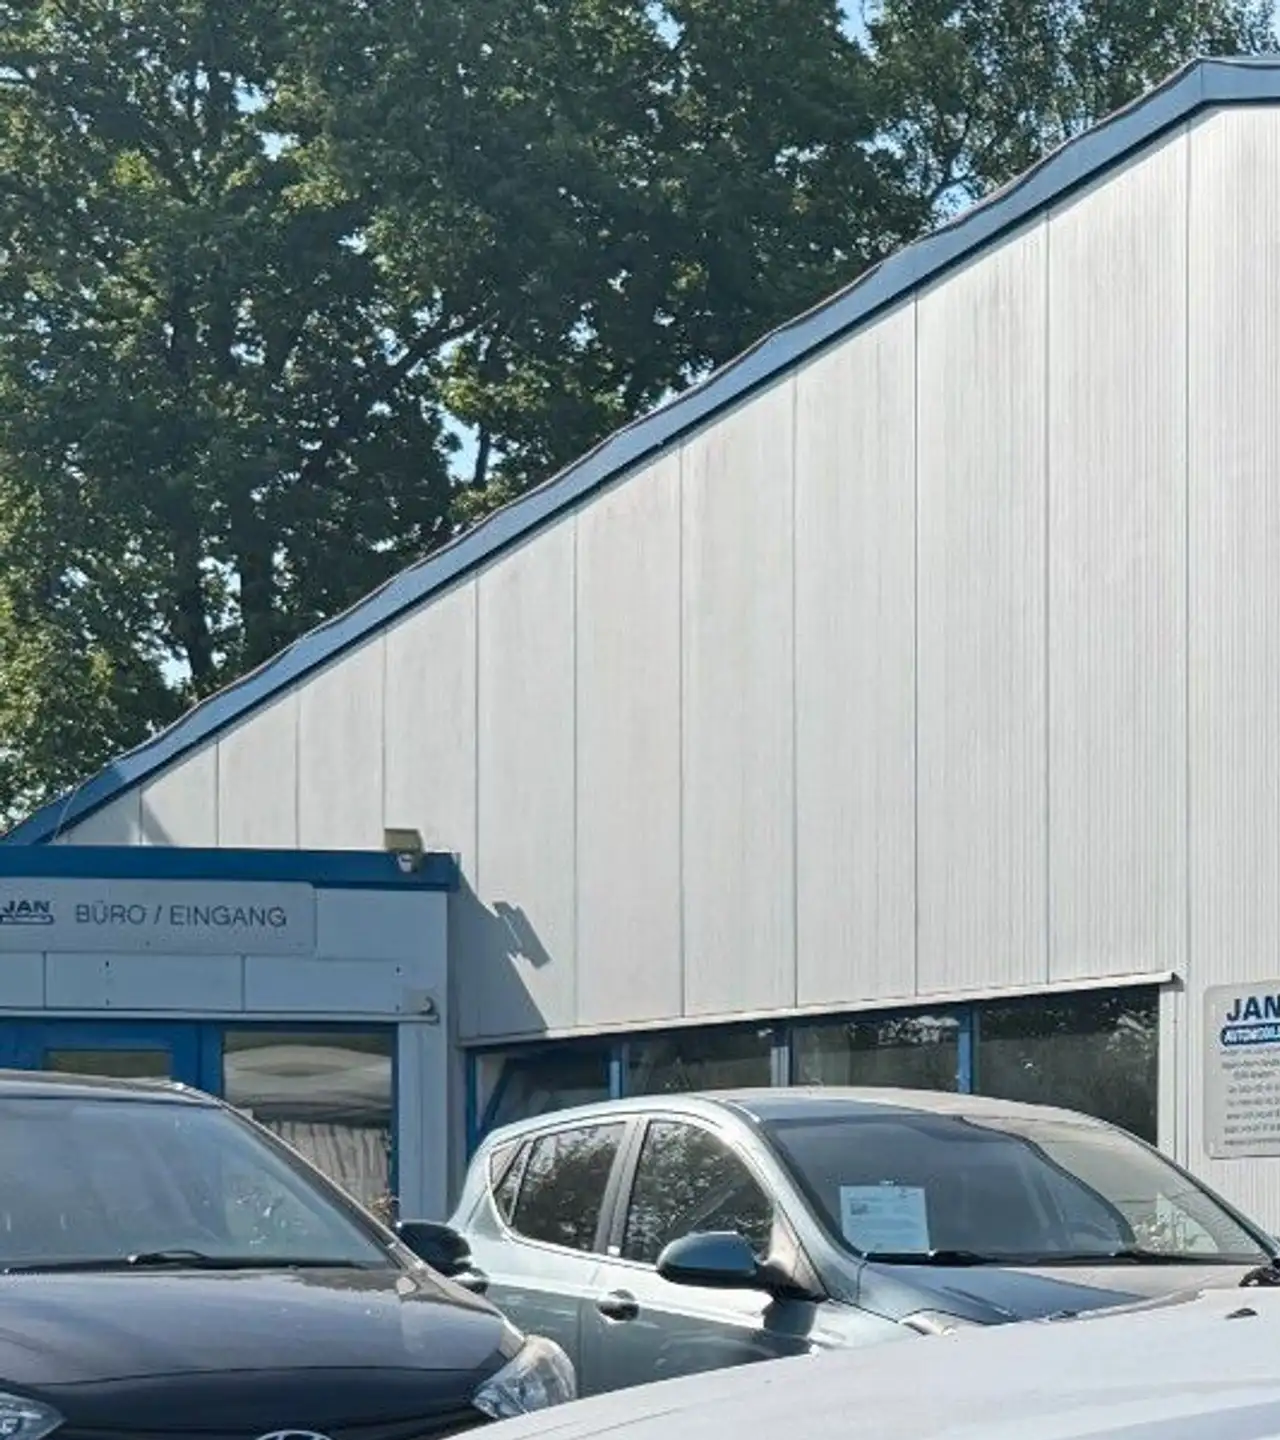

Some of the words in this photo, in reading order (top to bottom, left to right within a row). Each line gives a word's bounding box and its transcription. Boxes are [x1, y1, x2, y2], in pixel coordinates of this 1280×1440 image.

[2, 899, 52, 914] JAN
[75, 900, 147, 925] BÜRO
[169, 904, 288, 928] EINGANG
